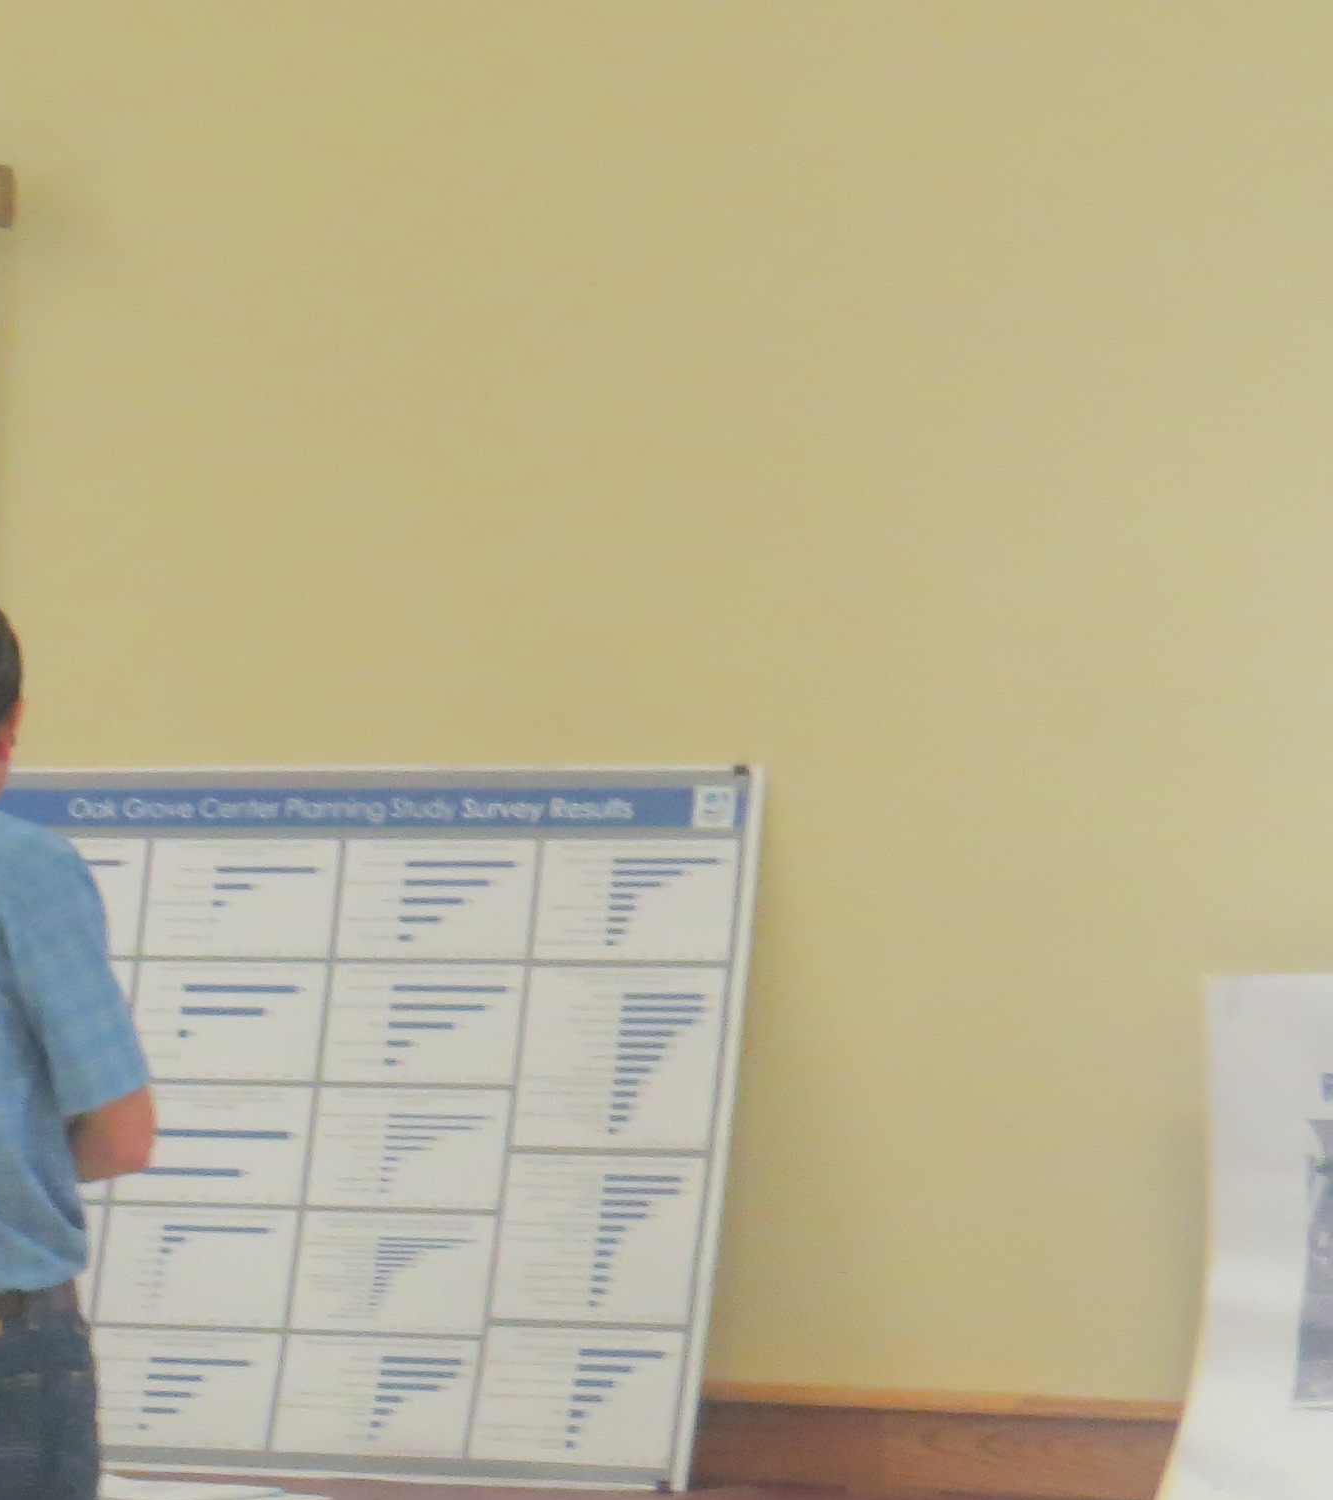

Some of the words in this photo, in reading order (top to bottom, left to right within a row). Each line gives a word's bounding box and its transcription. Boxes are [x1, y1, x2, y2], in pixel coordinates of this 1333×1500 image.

[68, 798, 116, 819] Oak
[122, 798, 196, 820] Grove
[199, 797, 280, 820] Center
[284, 797, 386, 824] Planning
[389, 797, 454, 824] Study
[462, 797, 546, 823] Survey
[549, 797, 634, 820] Results
